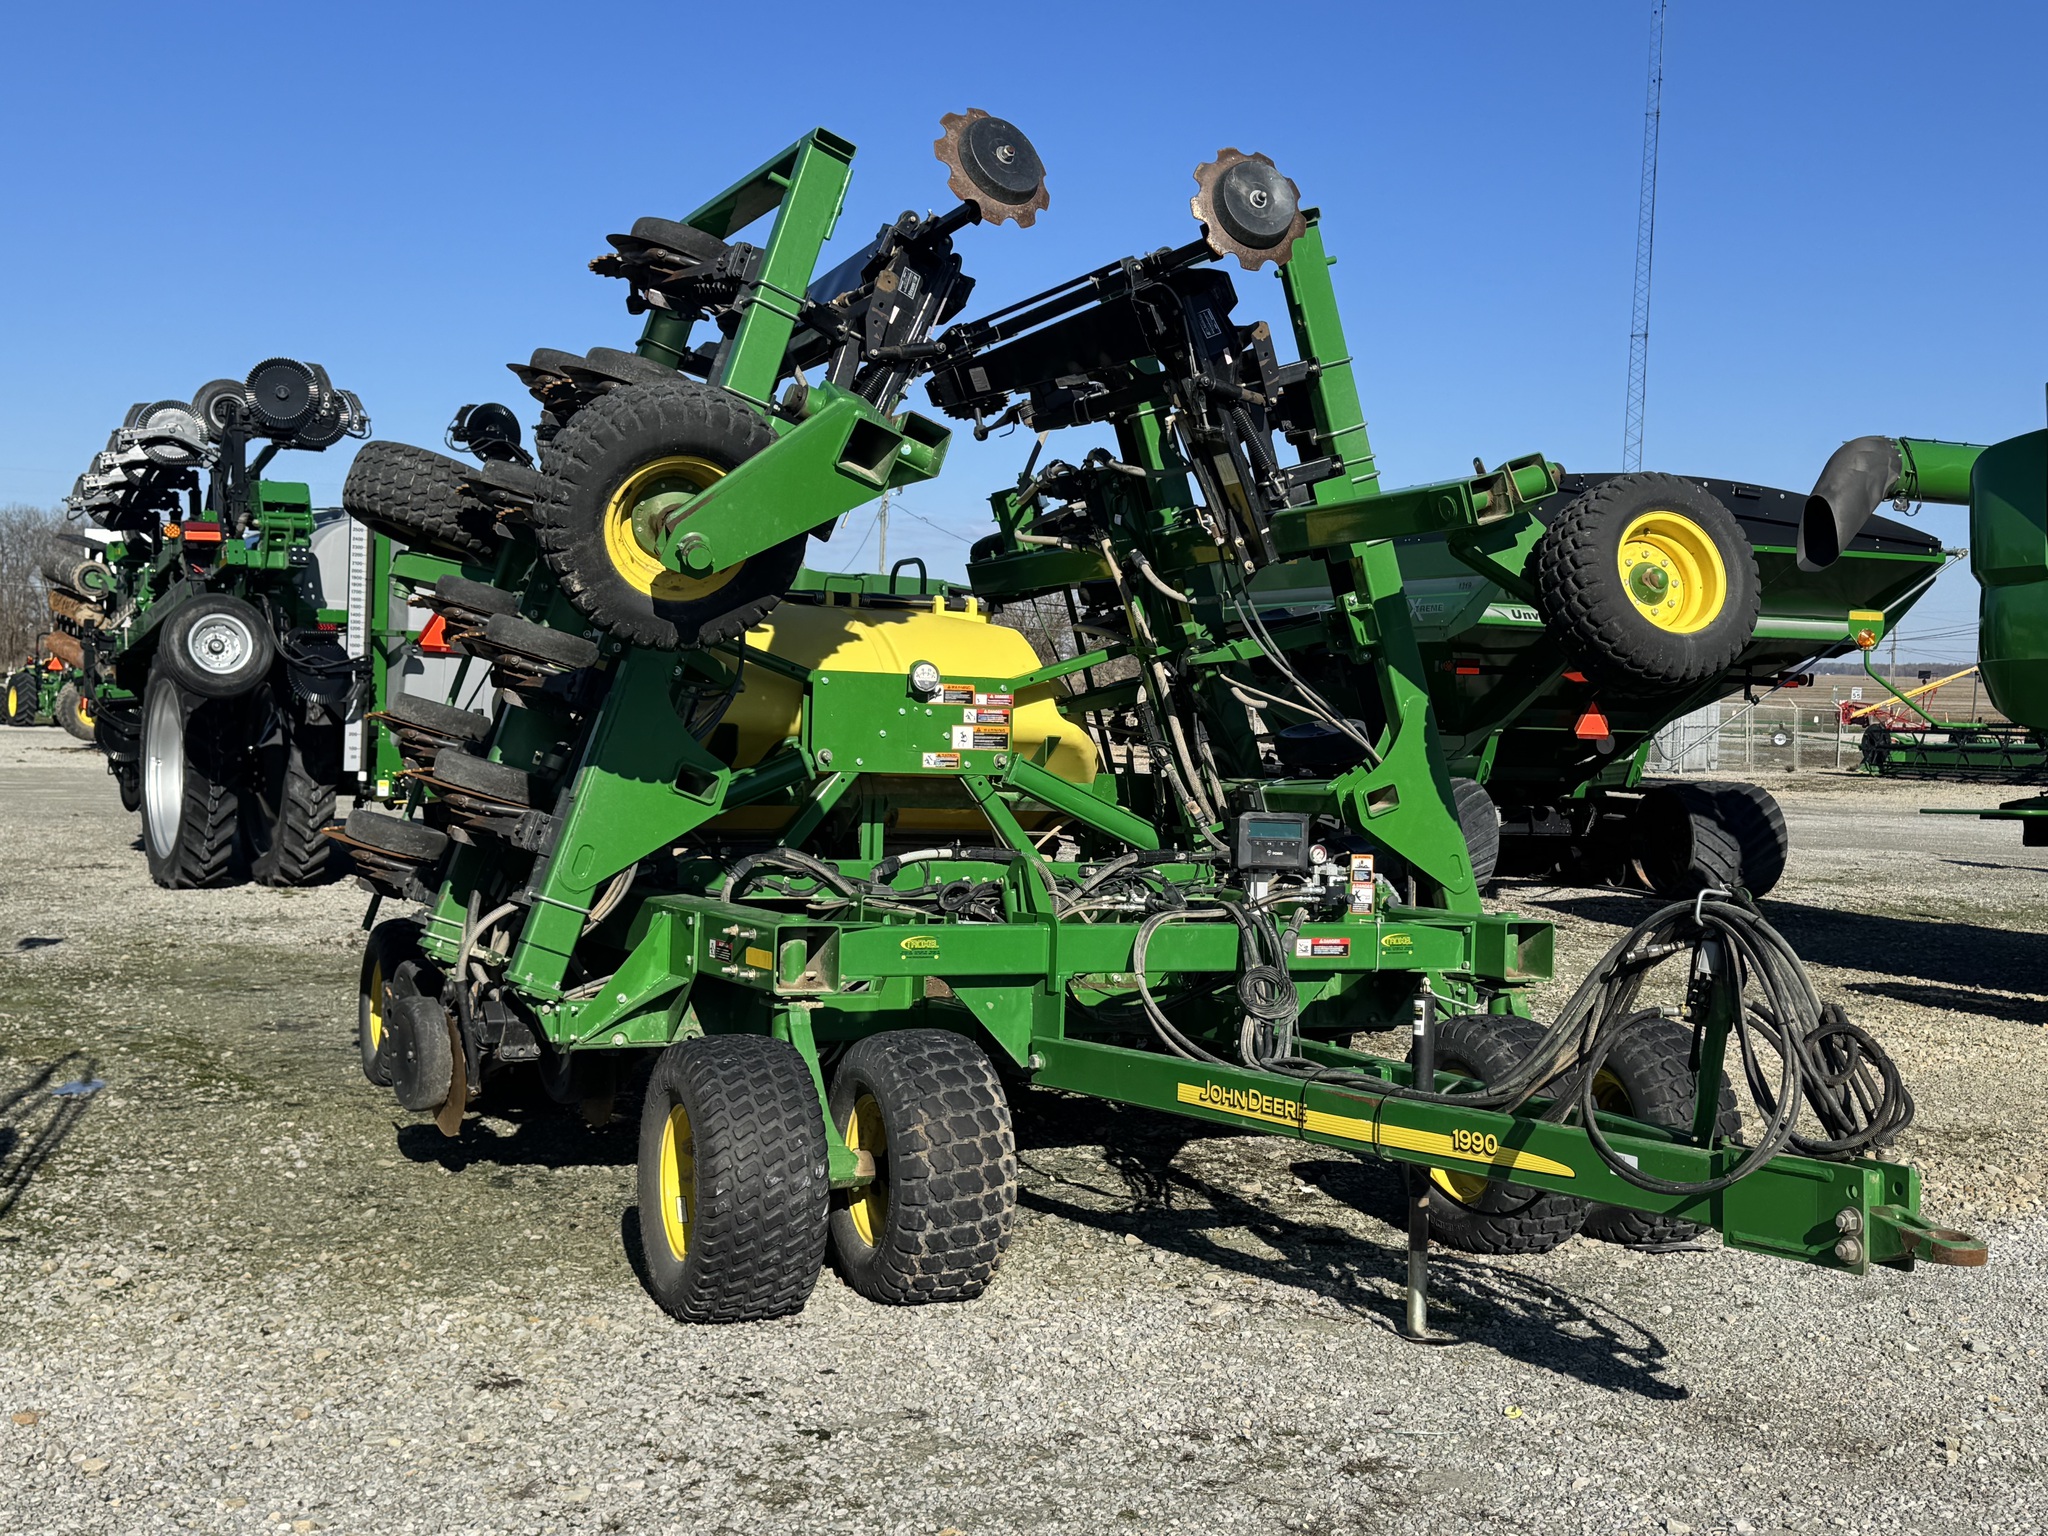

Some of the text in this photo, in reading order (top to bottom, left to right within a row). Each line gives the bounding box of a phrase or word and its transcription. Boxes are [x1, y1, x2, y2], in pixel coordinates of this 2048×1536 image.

[1511, 609, 1538, 620] Unv
[1200, 1080, 1308, 1122] JOHN DEERE
[1452, 1128, 1498, 1156] 1990
